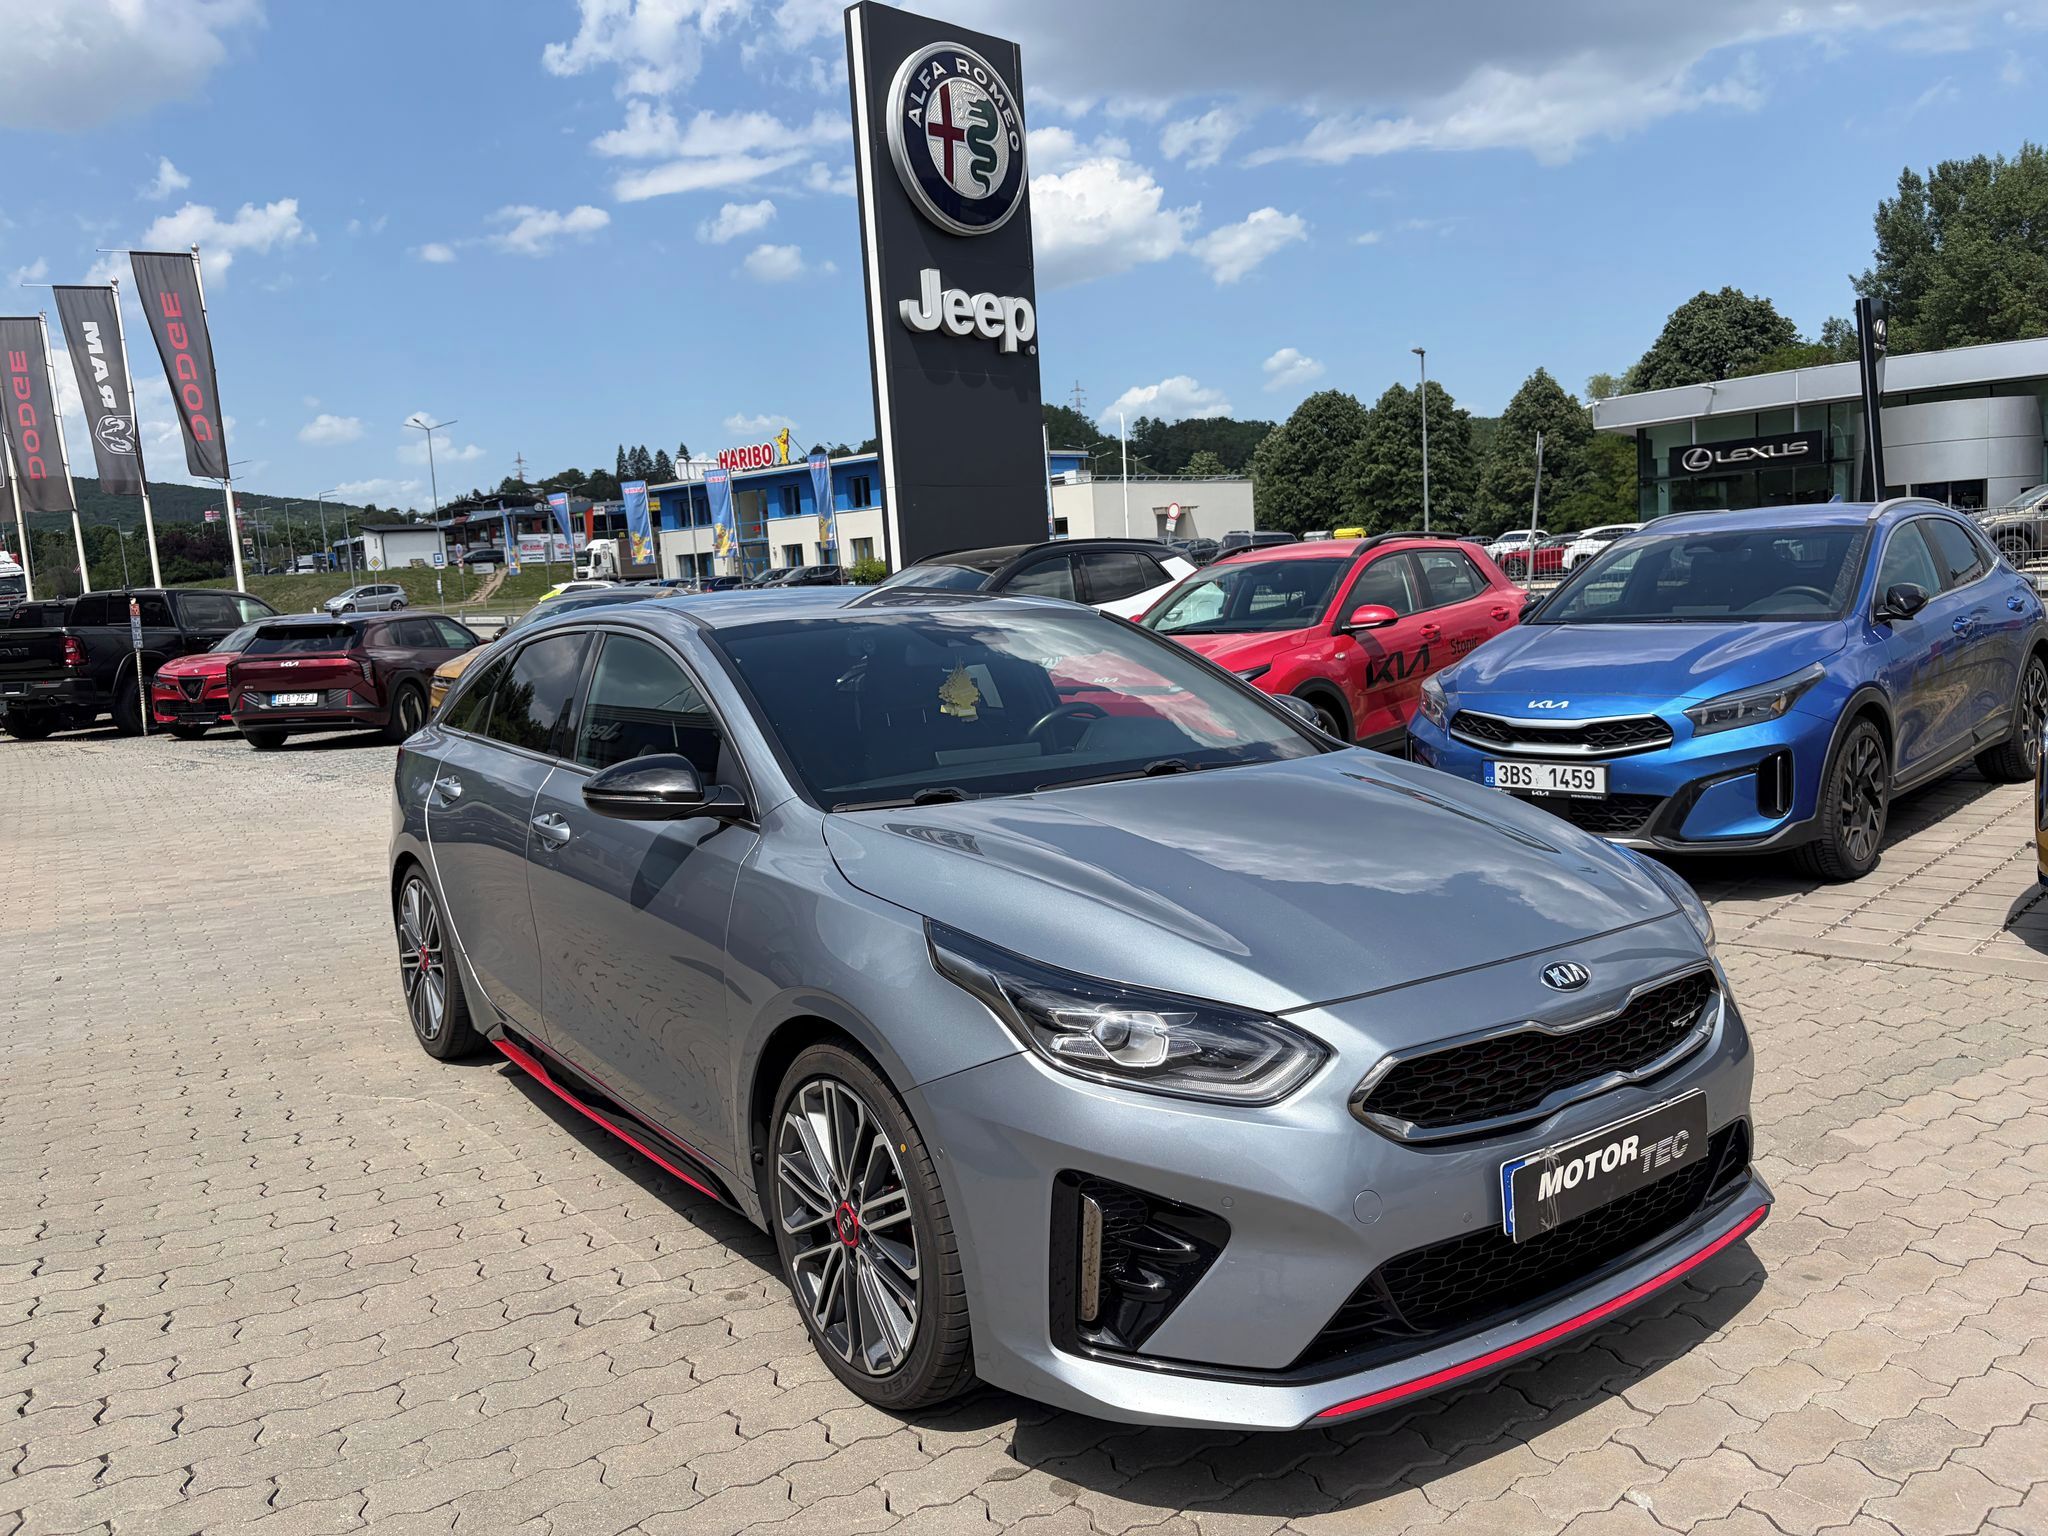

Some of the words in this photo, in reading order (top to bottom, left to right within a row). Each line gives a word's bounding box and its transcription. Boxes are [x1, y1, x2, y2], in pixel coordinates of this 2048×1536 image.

[907, 61, 948, 128] ALFA
[954, 57, 1021, 152] ROMEO
[718, 443, 773, 471] HARIBO
[1715, 440, 1809, 464] LEXUS
[1366, 643, 1430, 688] KIA
[1527, 699, 1569, 709] KIA
[1498, 765, 1532, 785] 3BS
[1549, 768, 1595, 790] 1459
[1547, 962, 1585, 987] KIA
[1537, 1134, 1640, 1202] MOTOR
[1639, 1130, 1690, 1174] TEC
[839, 1215, 852, 1234] KIA
